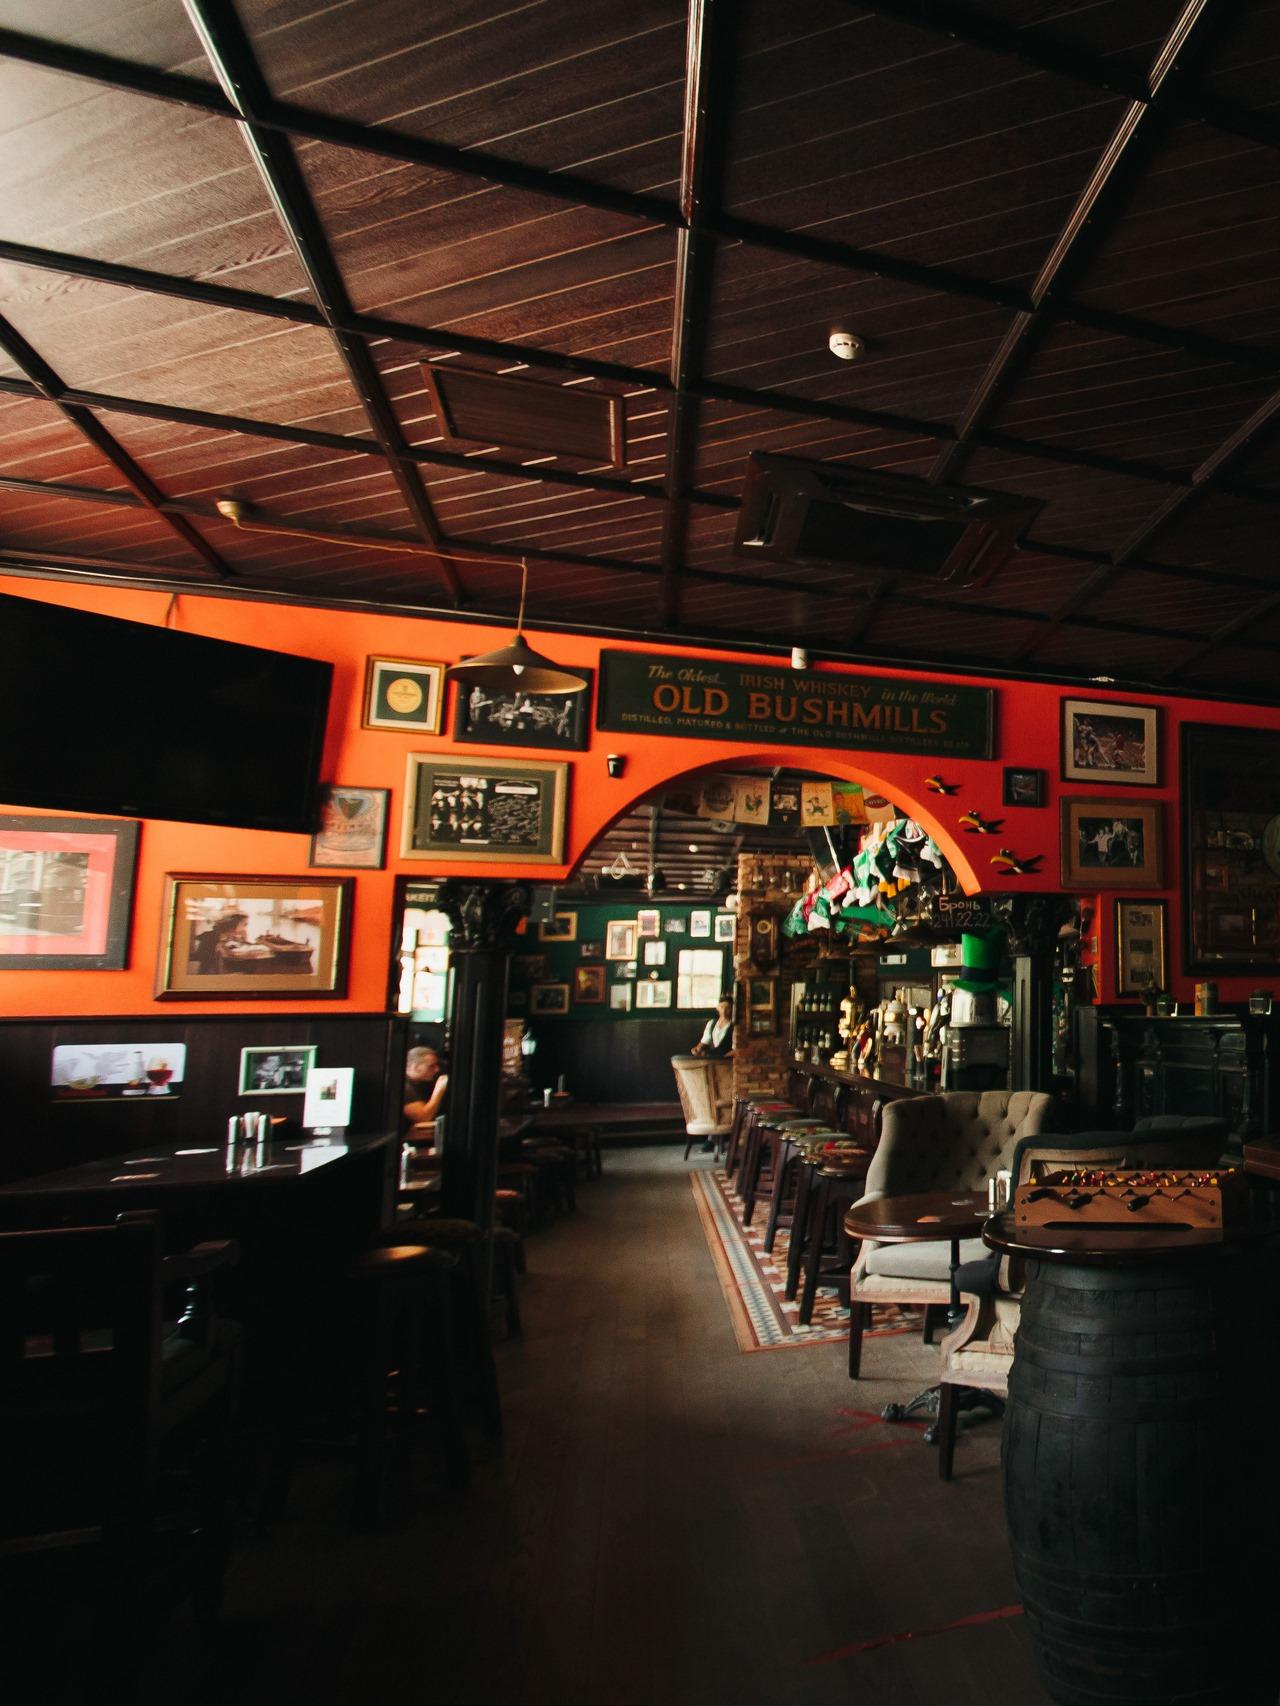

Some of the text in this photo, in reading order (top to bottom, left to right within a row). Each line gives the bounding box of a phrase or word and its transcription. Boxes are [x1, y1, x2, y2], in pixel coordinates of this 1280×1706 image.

[648, 665, 958, 706] The Oldest IRISH WHISKEY in the World
[651, 683, 951, 734] OLD BUSHMILLS
